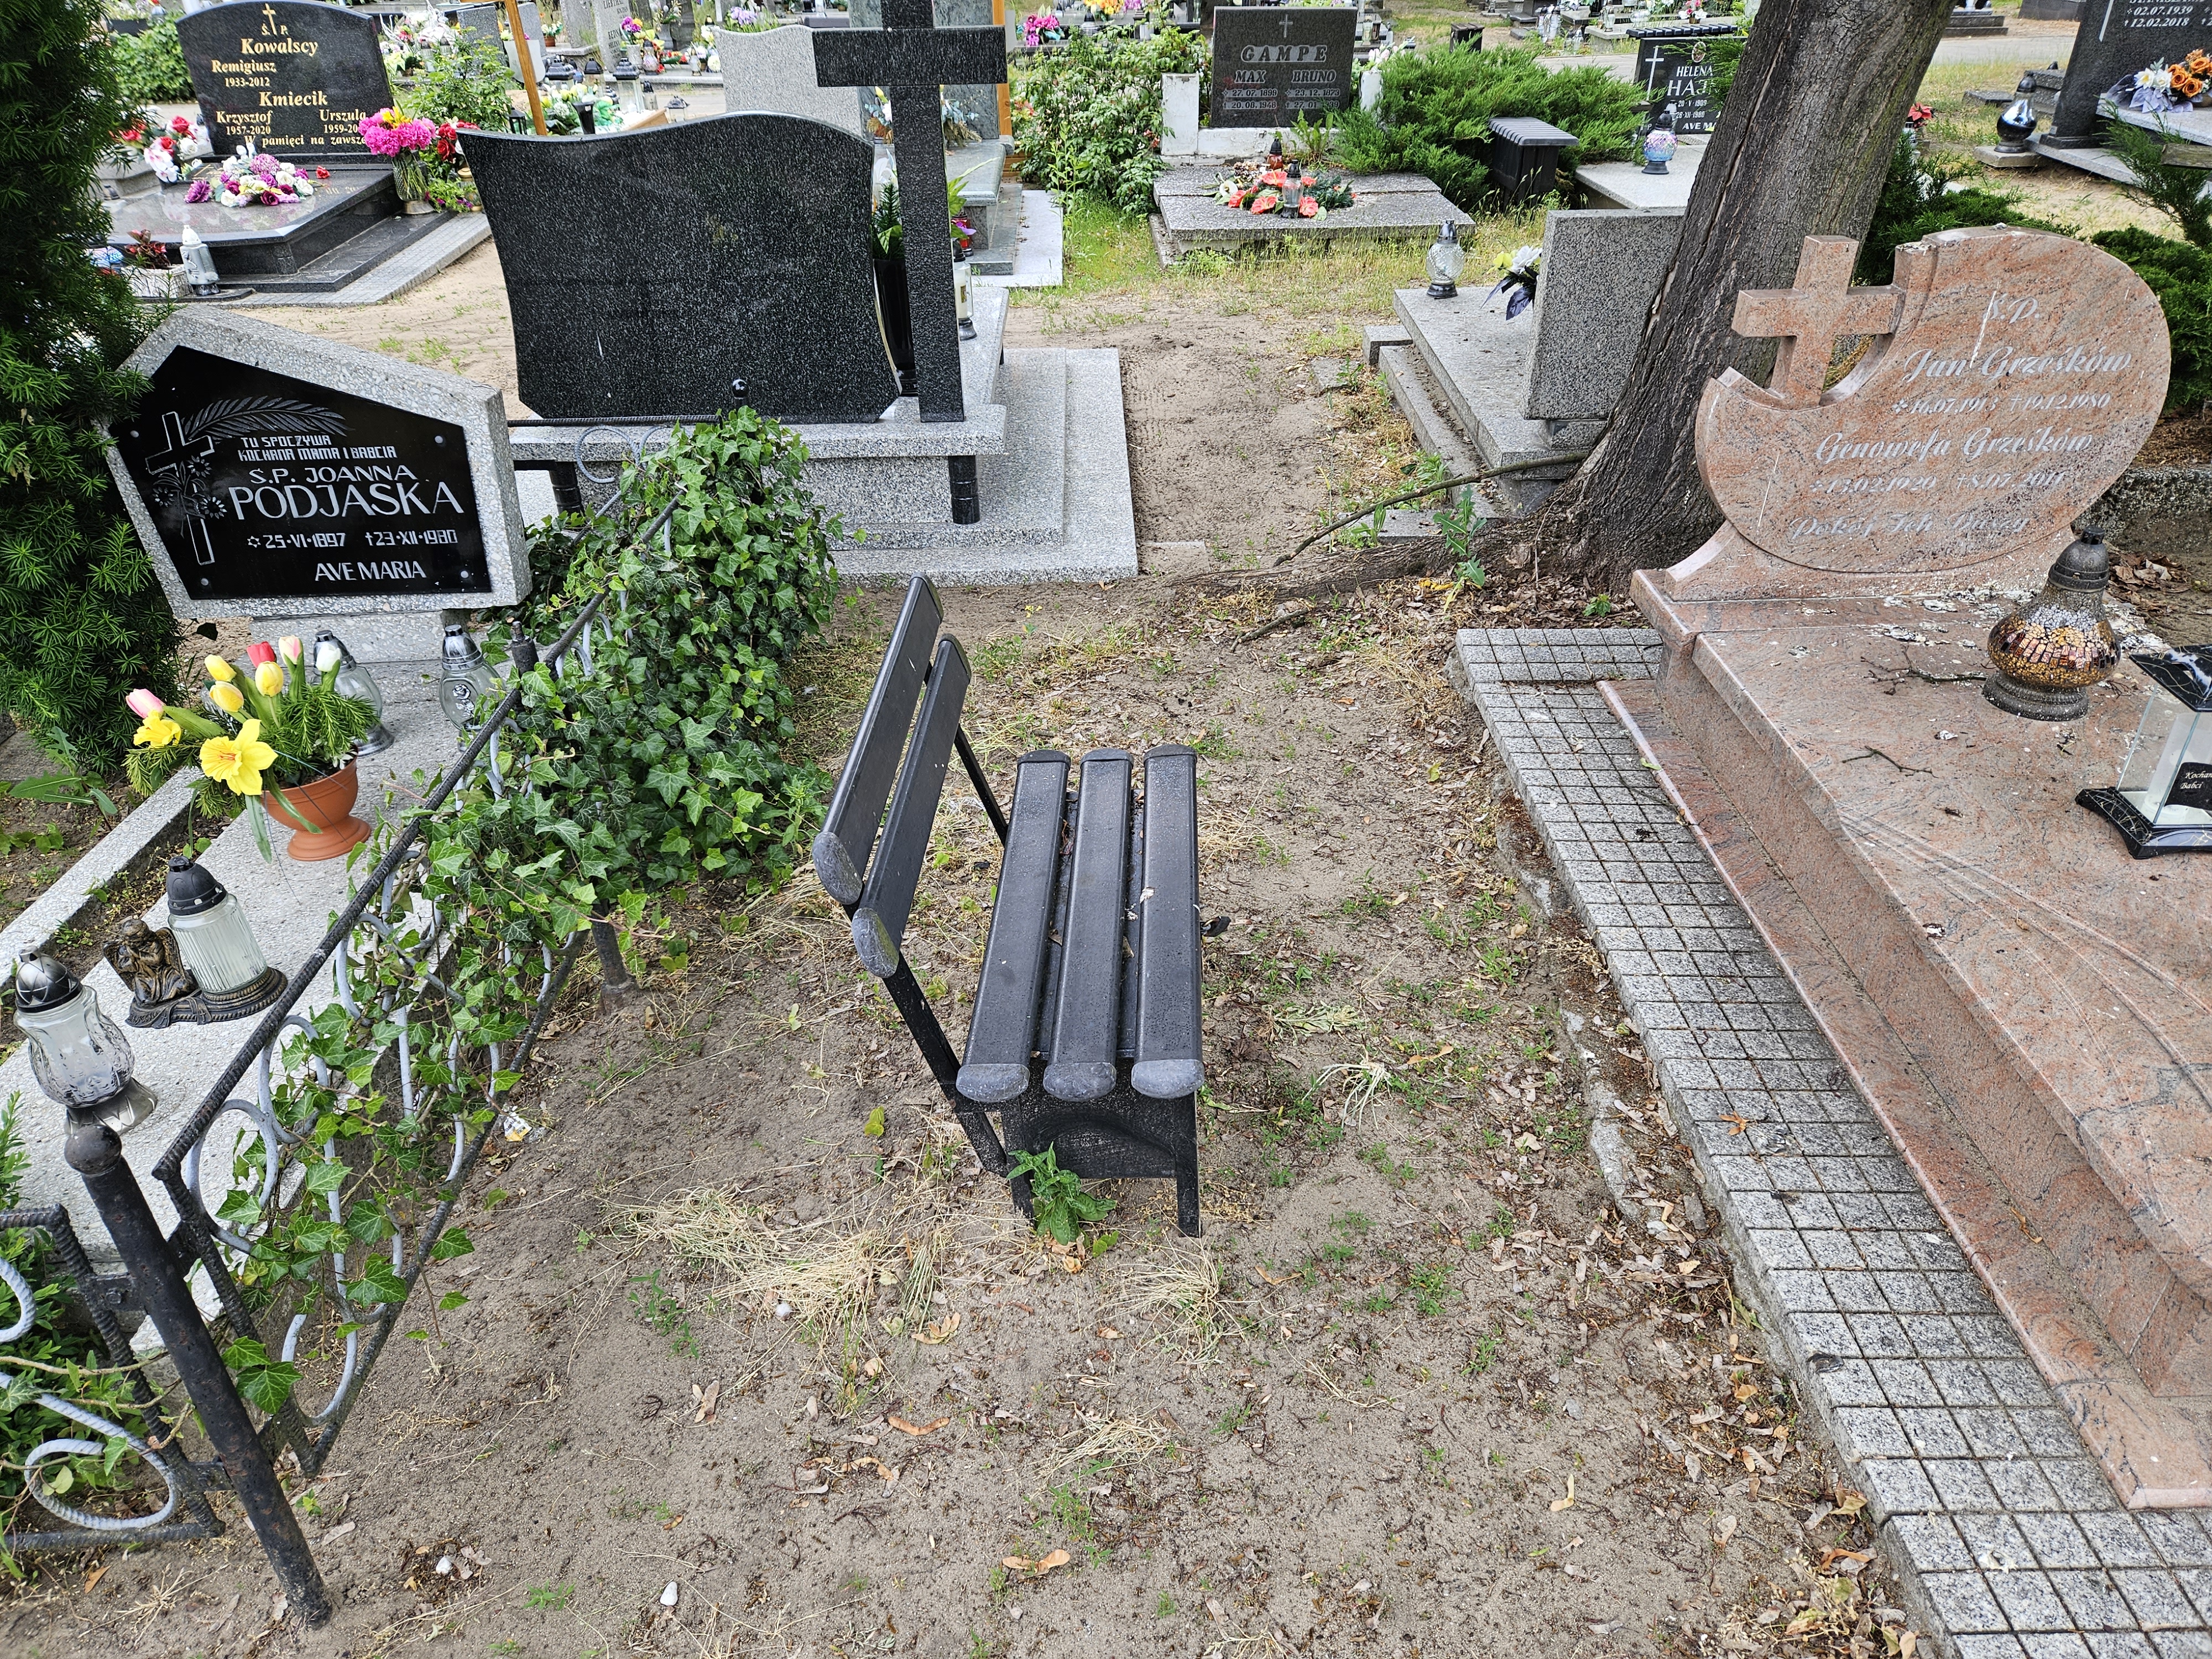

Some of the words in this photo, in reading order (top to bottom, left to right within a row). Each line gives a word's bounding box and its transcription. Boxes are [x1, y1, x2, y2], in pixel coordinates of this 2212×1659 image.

[2133, 6, 2193, 15] 02.07.1939
[2131, 18, 2189, 27] 12.02.2018
[241, 38, 319, 57] Kowalscy
[211, 59, 276, 75] Remigiusz
[1676, 65, 1713, 76] HELENA
[225, 77, 270, 87] 1933-2012
[1235, 70, 1266, 83] MAX
[1291, 70, 1337, 83] BRUNO
[259, 91, 327, 106] Kmiecik
[216, 111, 273, 124] Krzysztof
[320, 109, 366, 121] Urszula
[226, 126, 270, 135] 1957-2020
[262, 135, 304, 148] pamięci
[331, 136, 366, 144] zawsze
[1902, 348, 1966, 383] Jan
[1981, 345, 2132, 382] Grześków
[241, 437, 259, 448] TU
[261, 435, 332, 447] SPOCZYWA
[1814, 429, 1951, 465] Genowefa
[1961, 426, 2093, 461] Grześków
[238, 448, 296, 462] KOCHANA
[298, 447, 341, 460] MAMA
[343, 447, 349, 460] I
[351, 446, 398, 460] BABCIA
[305, 465, 418, 483] JOANNA
[228, 481, 465, 520] PODJASKA
[315, 562, 356, 581] AVE
[357, 560, 427, 580] MARIA
